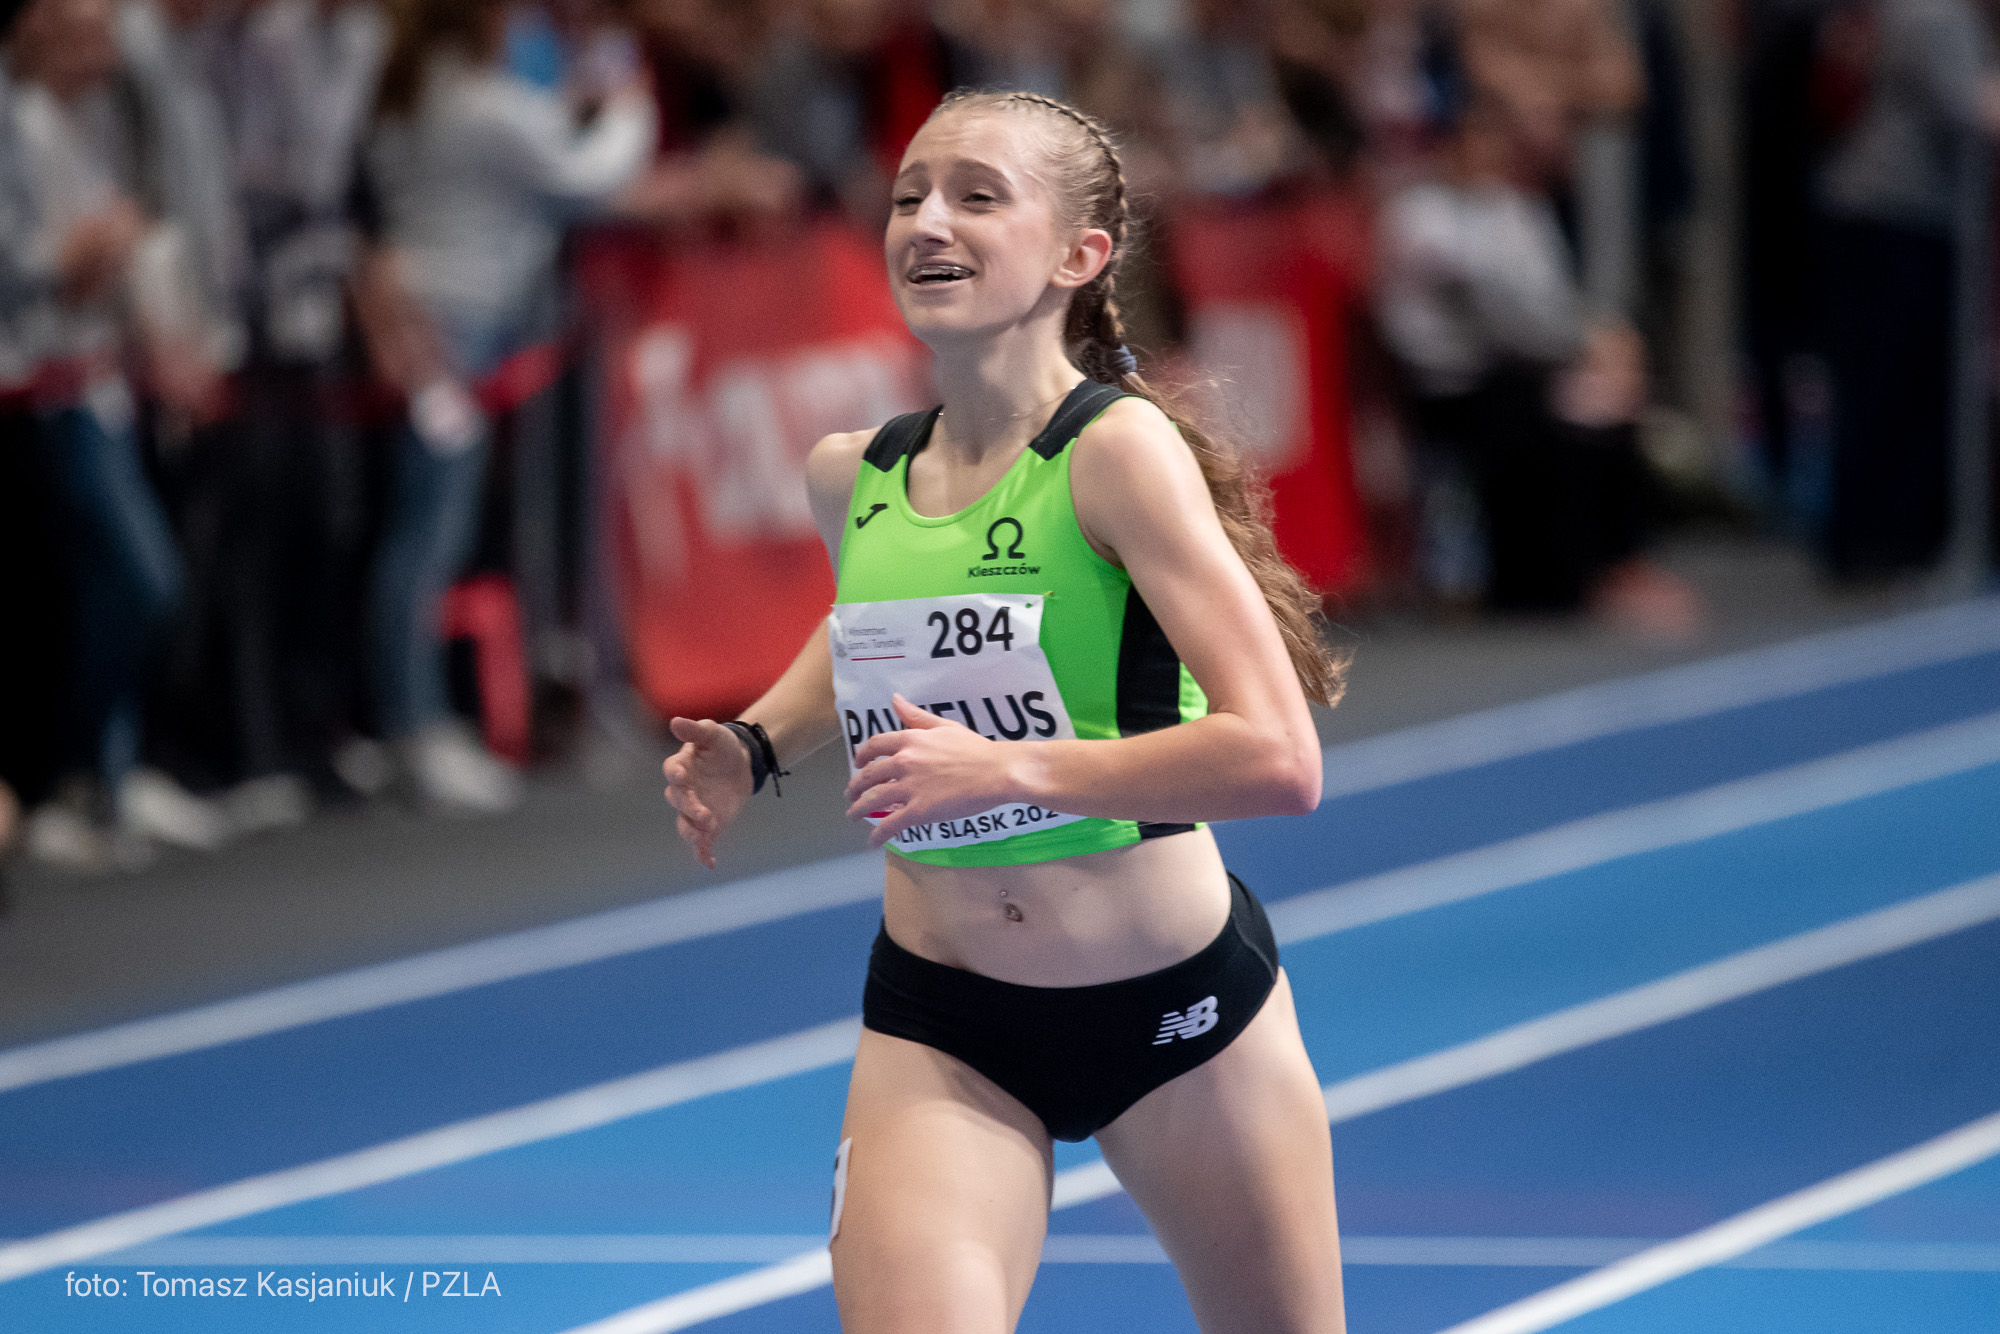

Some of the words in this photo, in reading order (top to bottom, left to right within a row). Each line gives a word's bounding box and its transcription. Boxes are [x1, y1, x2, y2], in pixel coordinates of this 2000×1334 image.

[967, 562, 1041, 578] Kleszczów
[927, 606, 1014, 659] 284
[844, 690, 1058, 759] PALUS
[895, 823, 933, 843] LNY
